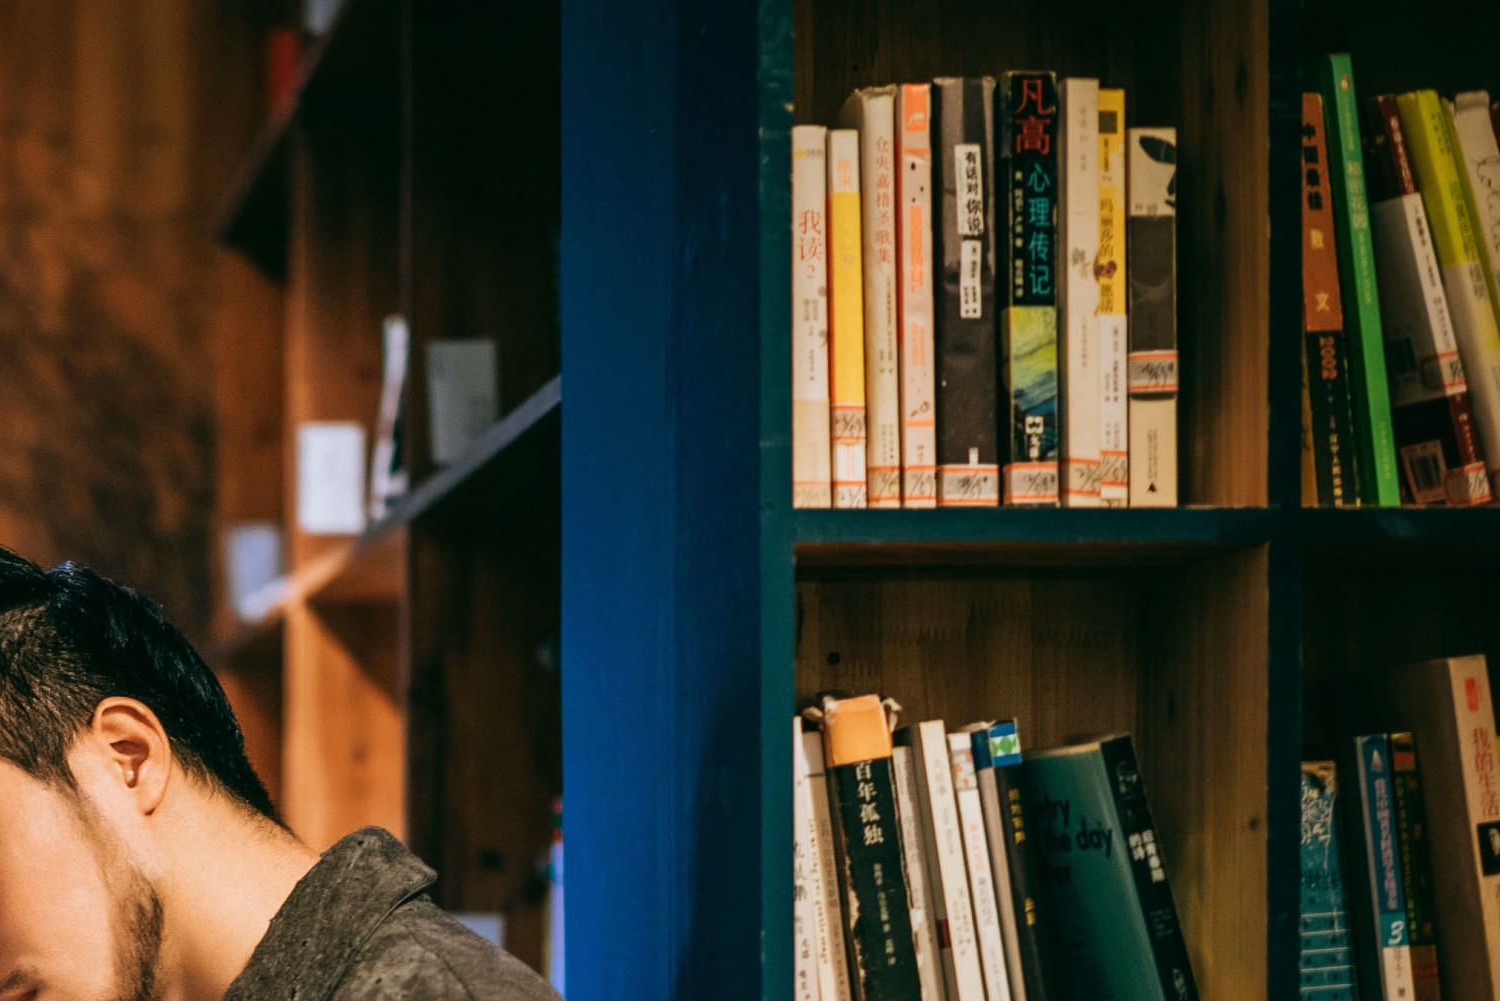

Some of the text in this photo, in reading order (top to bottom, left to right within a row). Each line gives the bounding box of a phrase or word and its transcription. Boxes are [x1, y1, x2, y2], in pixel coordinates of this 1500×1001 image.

[855, 761, 884, 846] 百年孤独
[1076, 818, 1112, 858] day
[1388, 920, 1404, 945] 3
